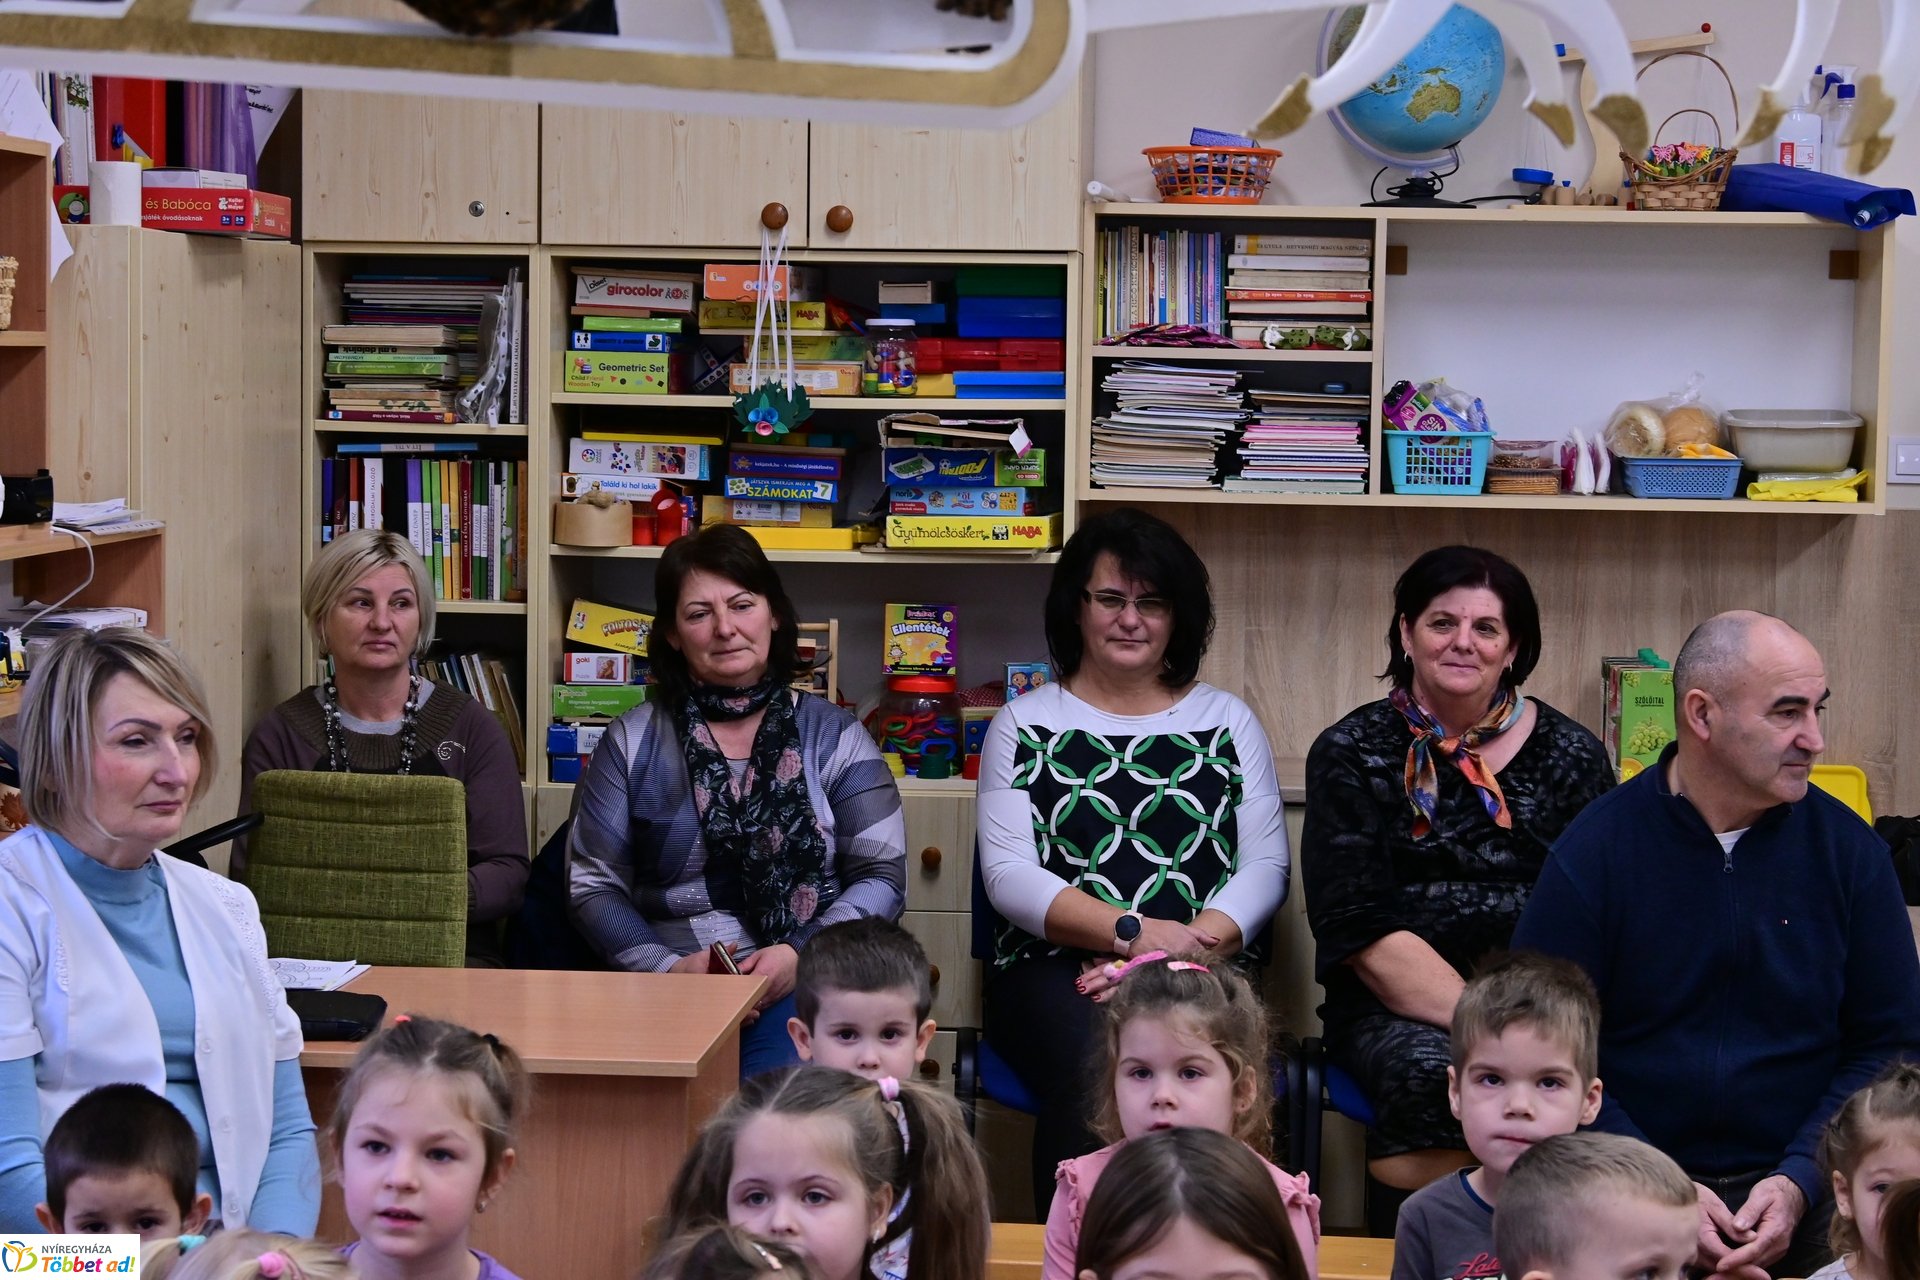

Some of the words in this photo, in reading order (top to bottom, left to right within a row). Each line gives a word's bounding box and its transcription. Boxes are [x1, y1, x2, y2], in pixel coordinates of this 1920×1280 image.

[145, 198, 158, 209] és
[162, 198, 211, 210] Babóca
[162, 214, 203, 222] óvodásoknak
[607, 282, 664, 298] girocolor
[796, 310, 820, 320] HABA
[599, 362, 647, 372] Geometric
[649, 364, 665, 373] Set
[600, 480, 620, 488] Találd
[622, 480, 628, 489] ki
[630, 482, 640, 490] hol
[642, 482, 658, 491] lakik
[747, 485, 813, 498] SZÁMOKAT
[820, 484, 830, 498] 7
[892, 523, 985, 544] Gyümölcsöskert
[1012, 526, 1042, 538] HABA
[891, 622, 950, 637] Ellentétek
[576, 656, 590, 664] goki
